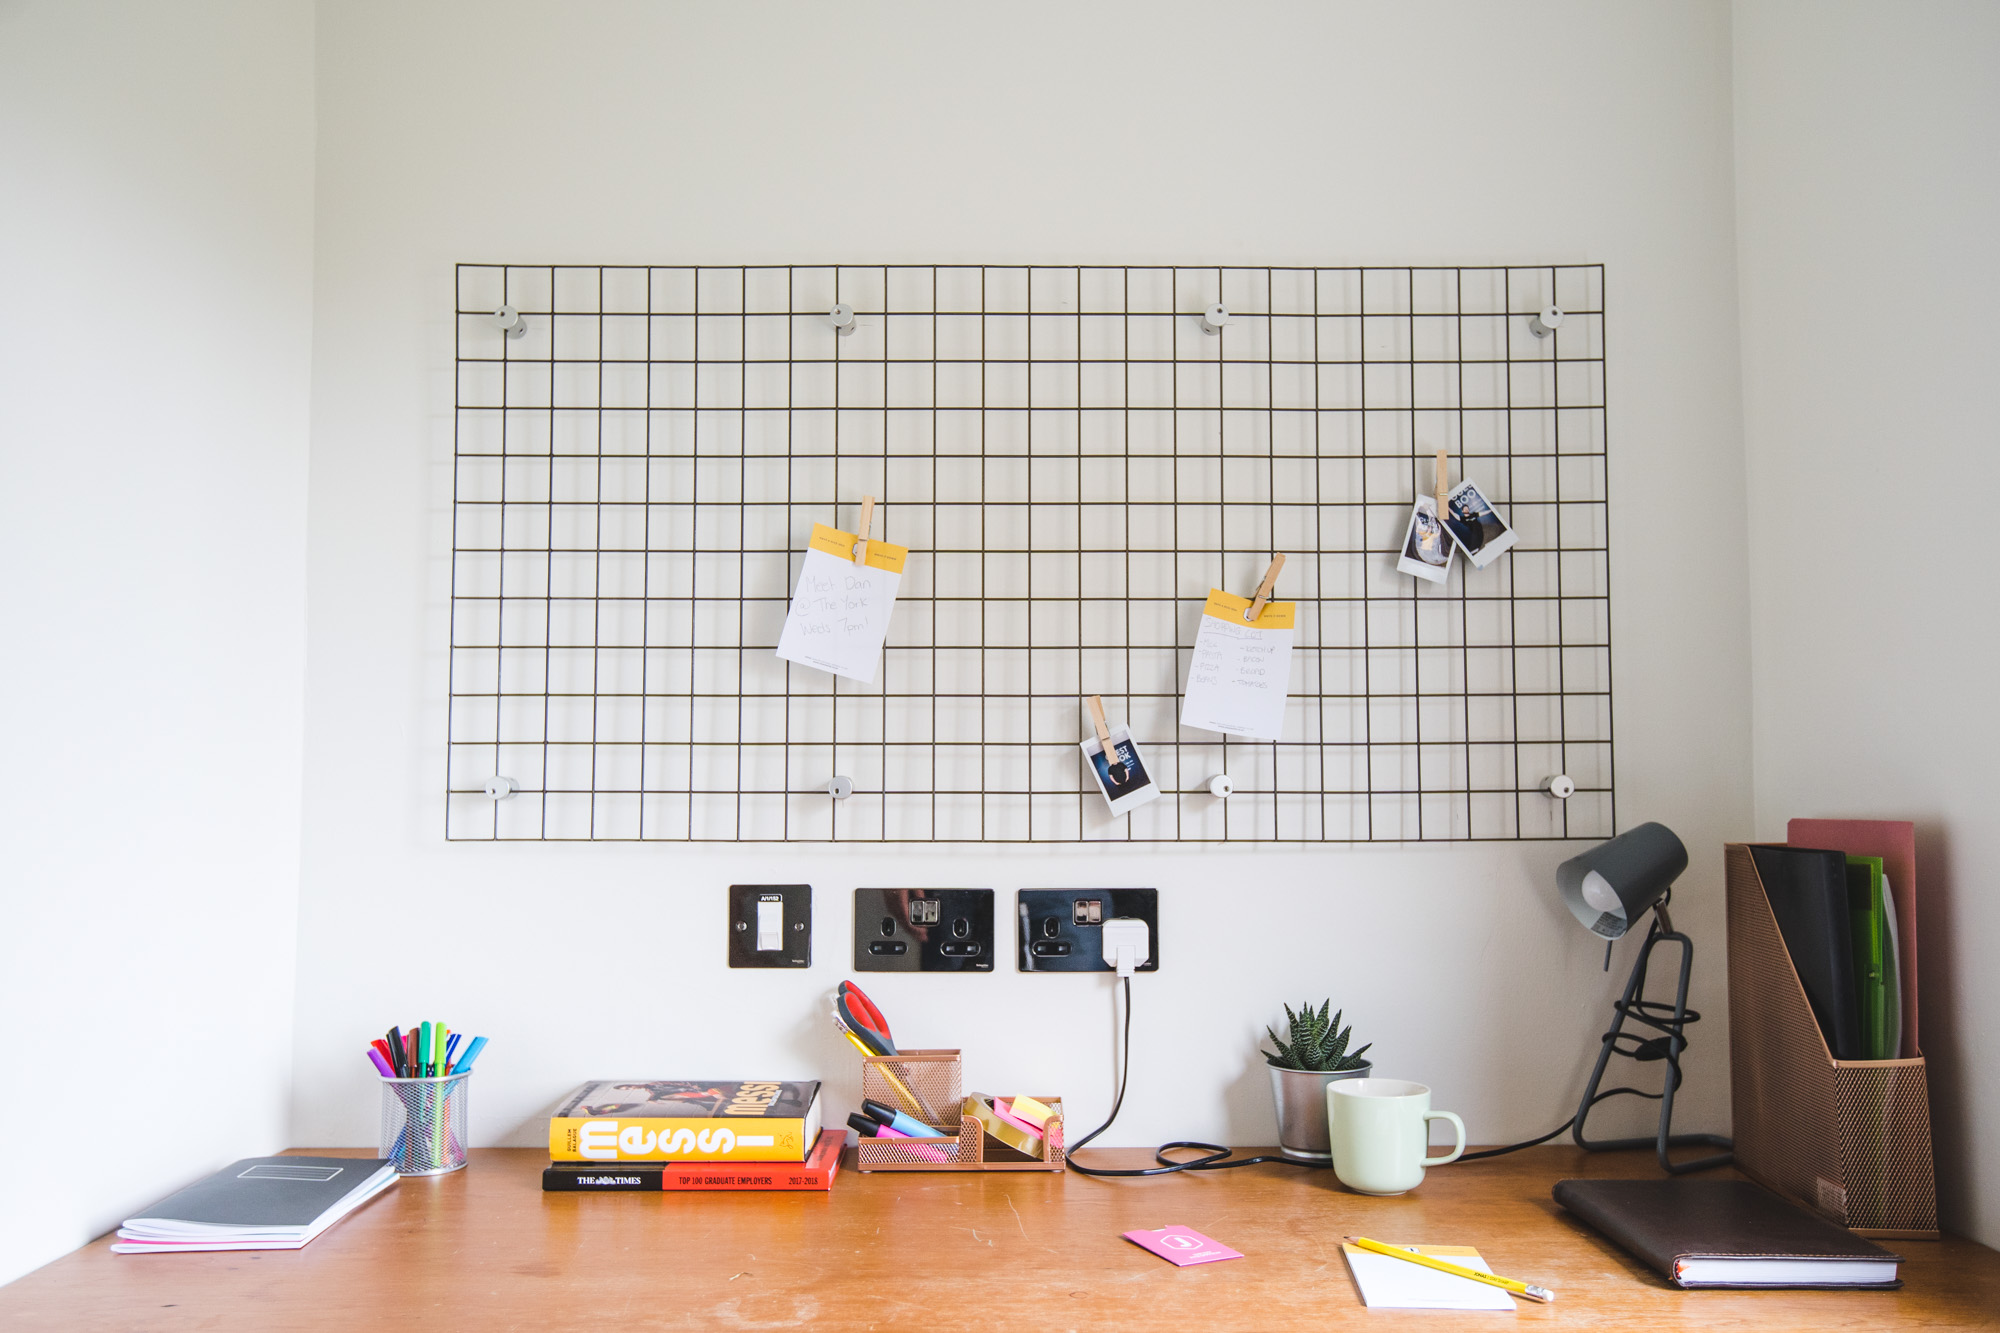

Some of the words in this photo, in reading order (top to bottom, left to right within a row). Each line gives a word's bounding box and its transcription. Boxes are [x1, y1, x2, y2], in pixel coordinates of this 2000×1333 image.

[804, 575, 836, 593] Meet
[844, 575, 872, 591] Dan
[813, 597, 838, 612] The
[577, 1176, 596, 1185] THE
[615, 1176, 642, 1185] TIMES
[679, 1176, 691, 1185] TOP
[692, 1176, 703, 1185] 100
[704, 1176, 736, 1185] GRADUATE
[737, 1176, 773, 1185] EMPLOYERS
[788, 1176, 819, 1185] 2017-2018
